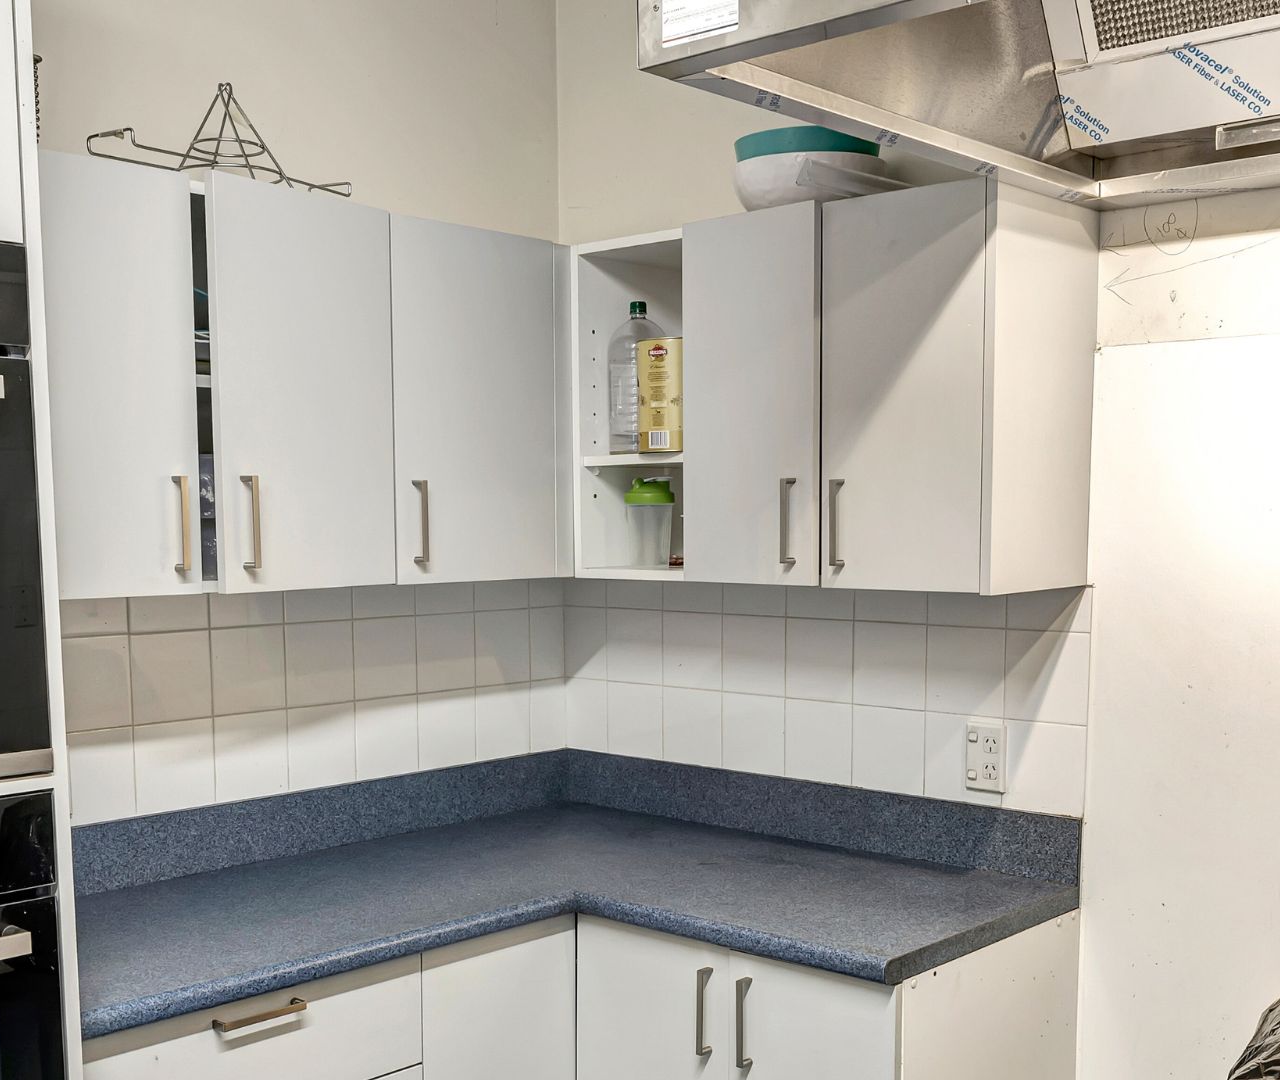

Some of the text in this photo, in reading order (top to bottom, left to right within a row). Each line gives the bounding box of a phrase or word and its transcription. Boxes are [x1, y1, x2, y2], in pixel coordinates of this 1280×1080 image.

[1192, 63, 1215, 81] Fiber
[1220, 82, 1248, 105] LASER
[1232, 75, 1271, 107] Solution
[1063, 111, 1089, 133] LASER
[1074, 105, 1110, 135] Solution
